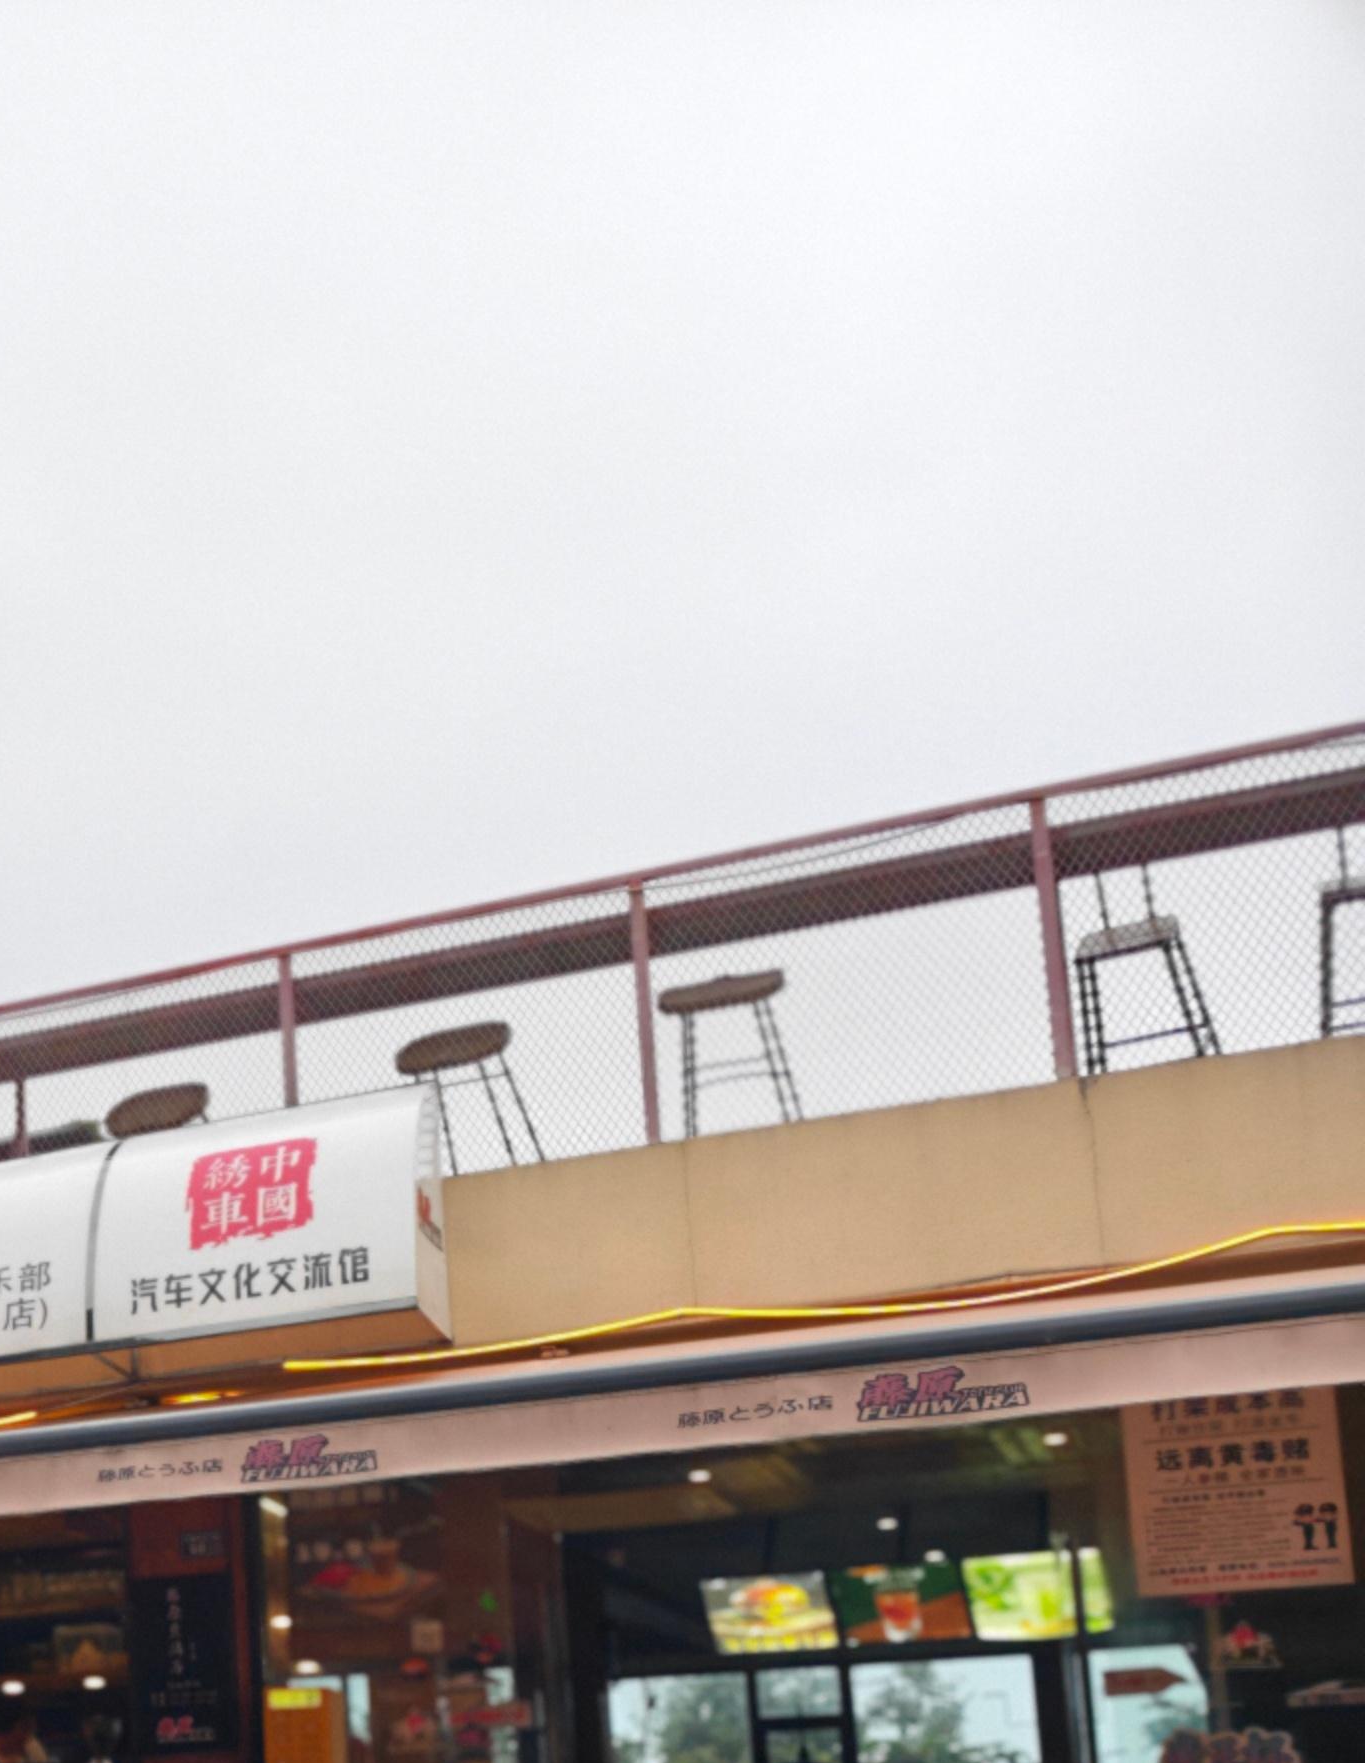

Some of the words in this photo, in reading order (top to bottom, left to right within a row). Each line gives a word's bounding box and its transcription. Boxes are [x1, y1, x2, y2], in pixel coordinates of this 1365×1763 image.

[129, 1246, 370, 1314] 汽车文化交流馆
[677, 1394, 834, 1429] 藤原とうふ店
[97, 1458, 223, 1483] 藤原とうふ店
